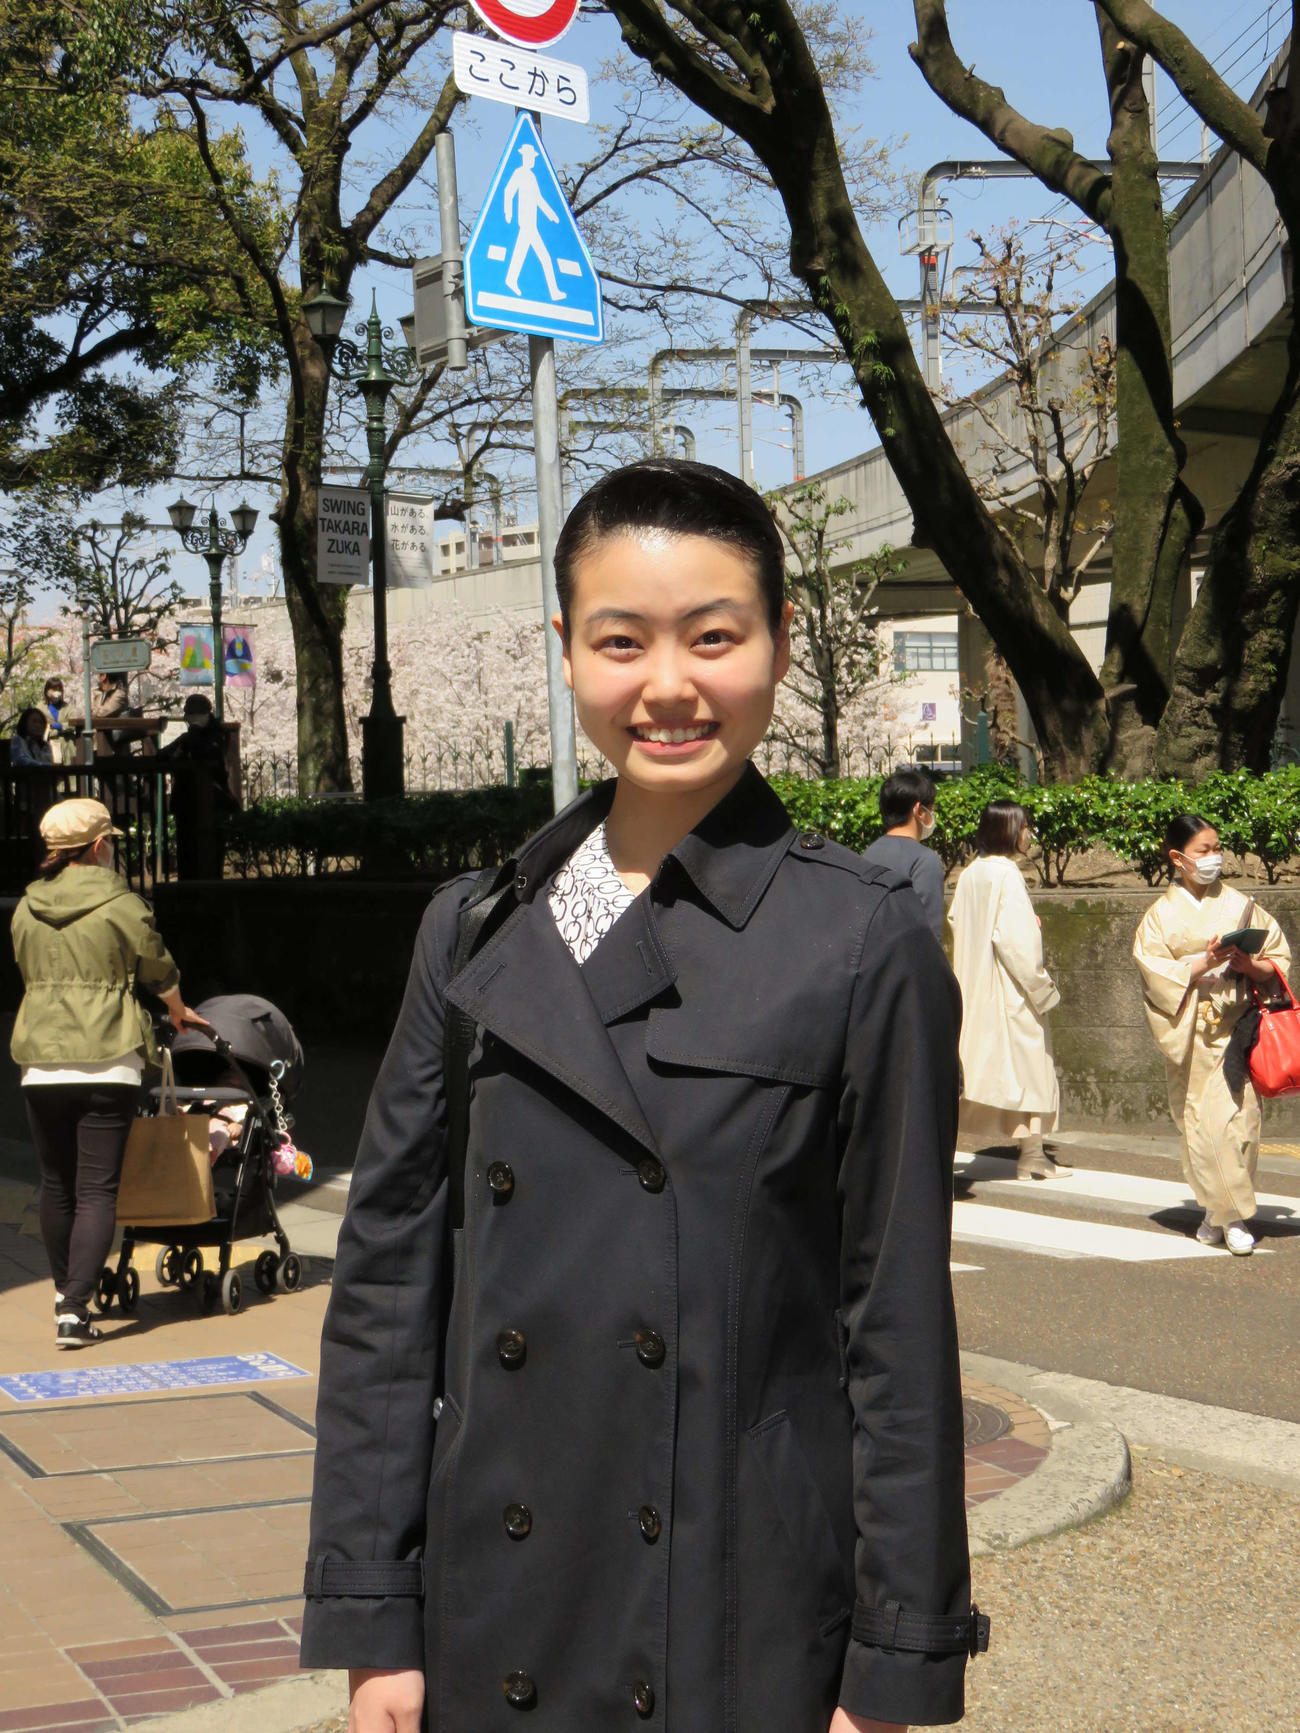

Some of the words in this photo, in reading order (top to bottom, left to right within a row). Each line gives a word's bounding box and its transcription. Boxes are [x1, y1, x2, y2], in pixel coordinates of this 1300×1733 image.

[469, 50, 577, 106] ここから
[322, 498, 366, 516] SWING
[320, 518, 369, 537] TAKARA
[327, 538, 361, 556] ZUKA
